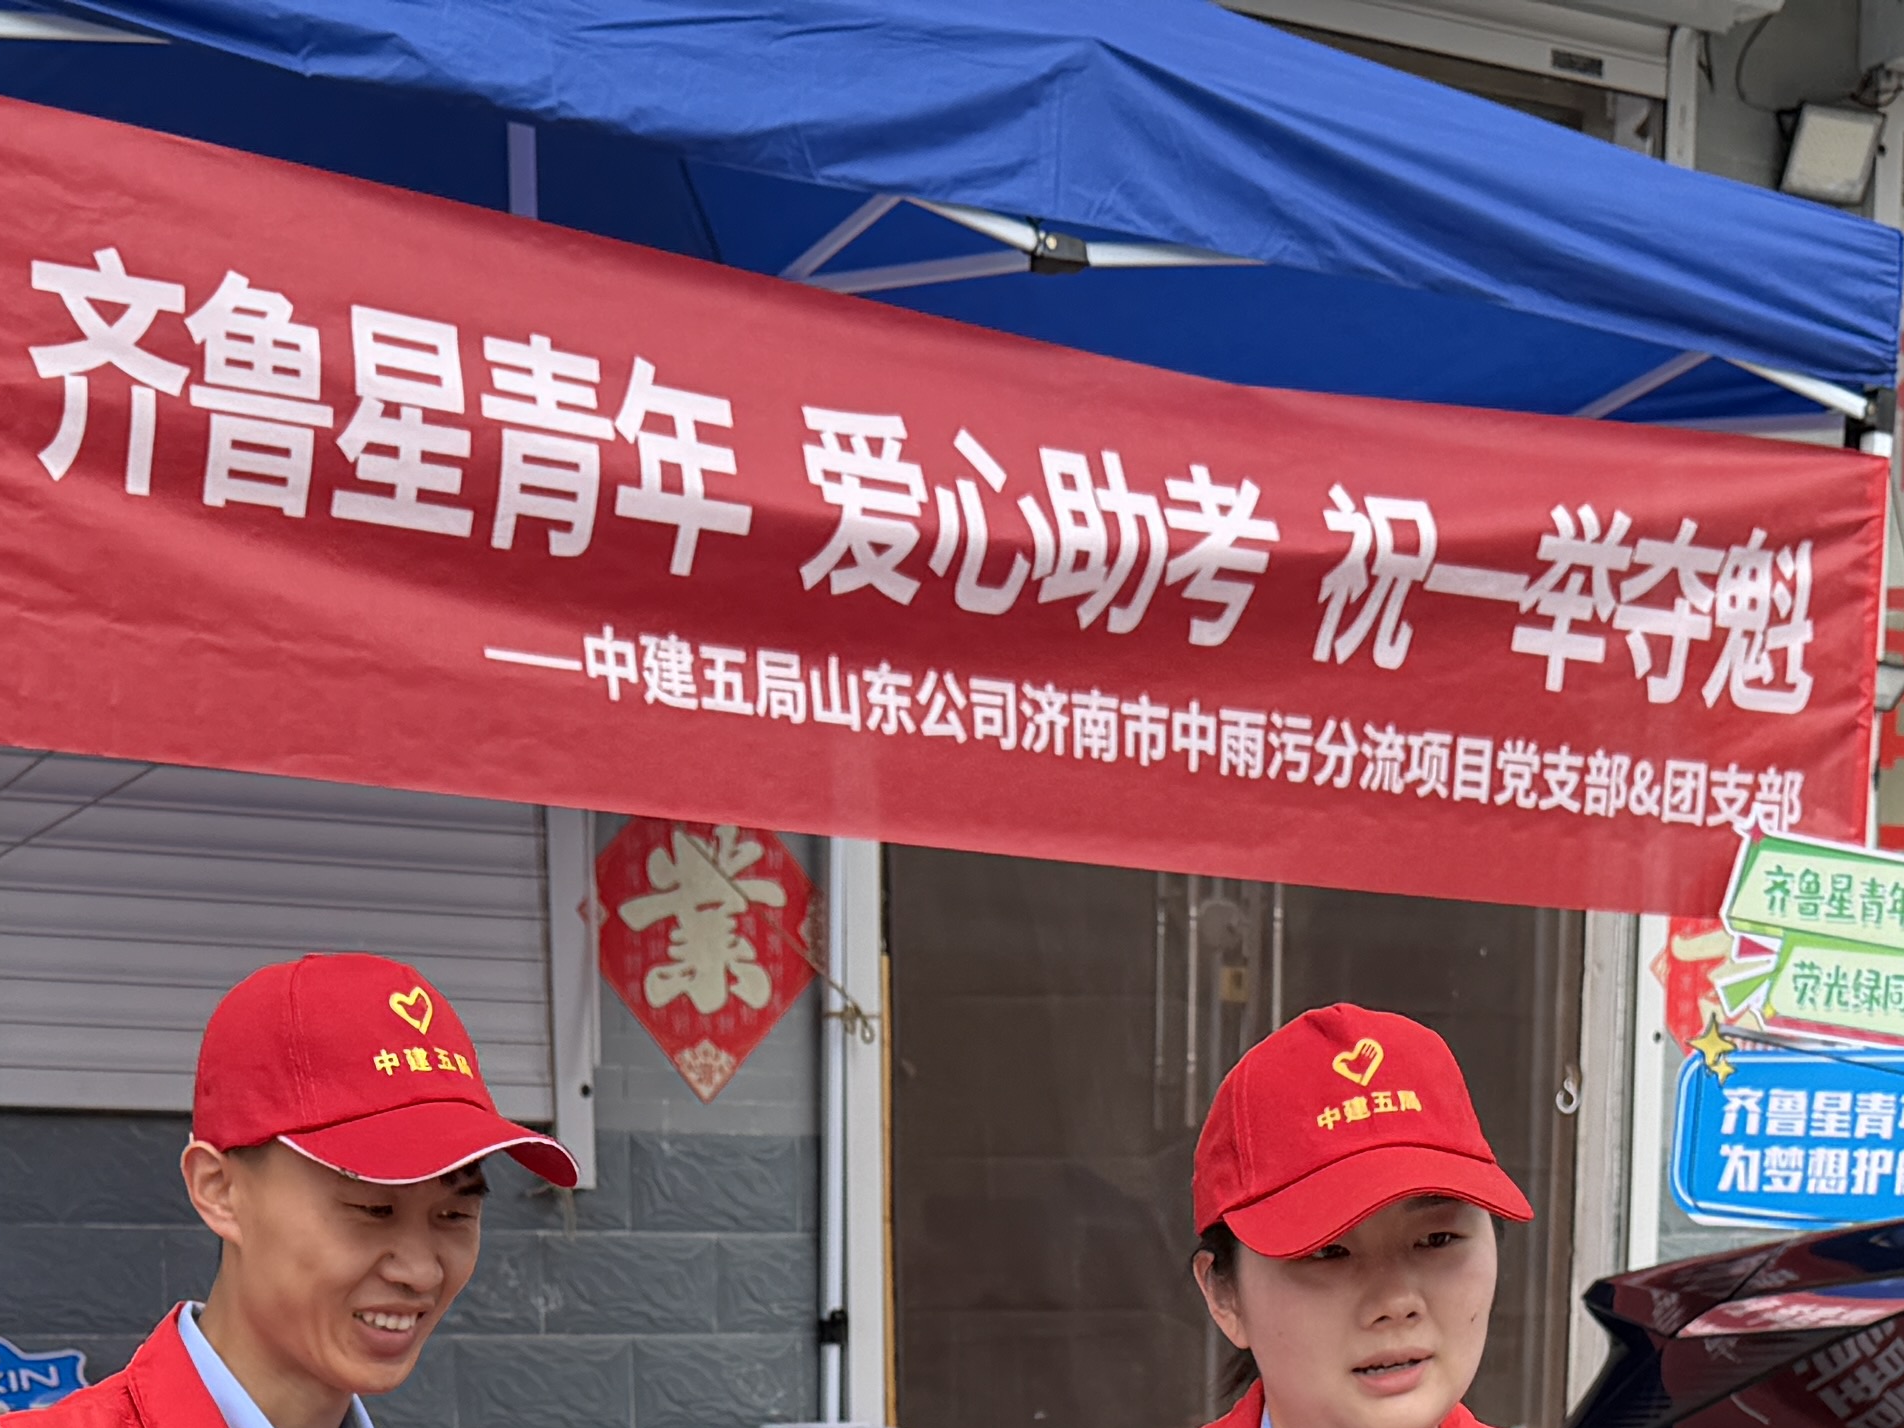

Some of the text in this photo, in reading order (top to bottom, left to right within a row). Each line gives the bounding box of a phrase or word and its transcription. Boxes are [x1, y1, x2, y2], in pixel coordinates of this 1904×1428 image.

[27, 247, 1816, 714] 齐鲁星青年 爱心助考 祝一举夺魁
[374, 1046, 474, 1079] 中建五局
[1317, 1090, 1422, 1129] 中建五局
